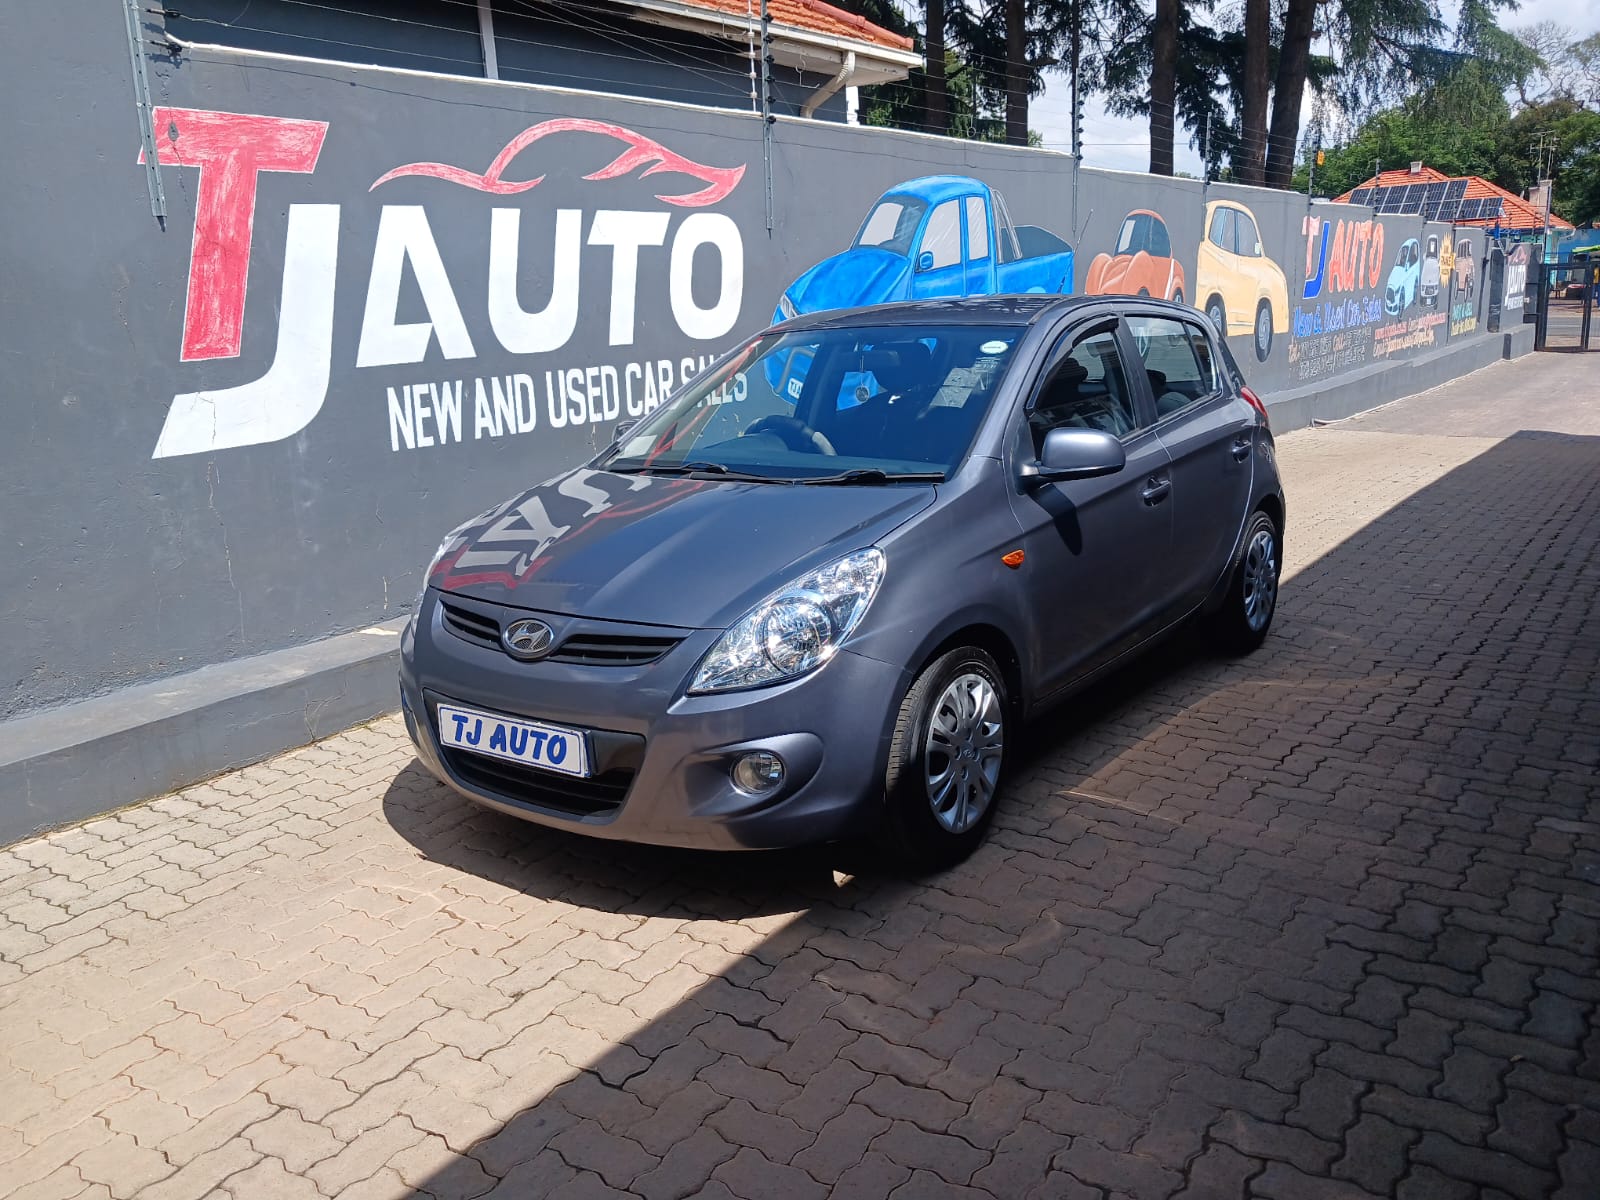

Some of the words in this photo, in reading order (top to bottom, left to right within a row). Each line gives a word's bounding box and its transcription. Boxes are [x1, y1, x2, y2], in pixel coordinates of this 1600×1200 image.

[137, 105, 341, 460] TJ
[355, 204, 744, 368] AUTO
[1301, 215, 1331, 299] TJ
[1328, 218, 1384, 293] AUTO
[1293, 305, 1313, 338] New
[1324, 298, 1346, 333] Used
[1362, 294, 1382, 326] Sales
[386, 379, 464, 452] NEW
[474, 372, 537, 440] AND
[545, 365, 620, 428] USED
[625, 359, 674, 417] CAR
[452, 714, 483, 746] TJ
[489, 723, 567, 765] AUTO
